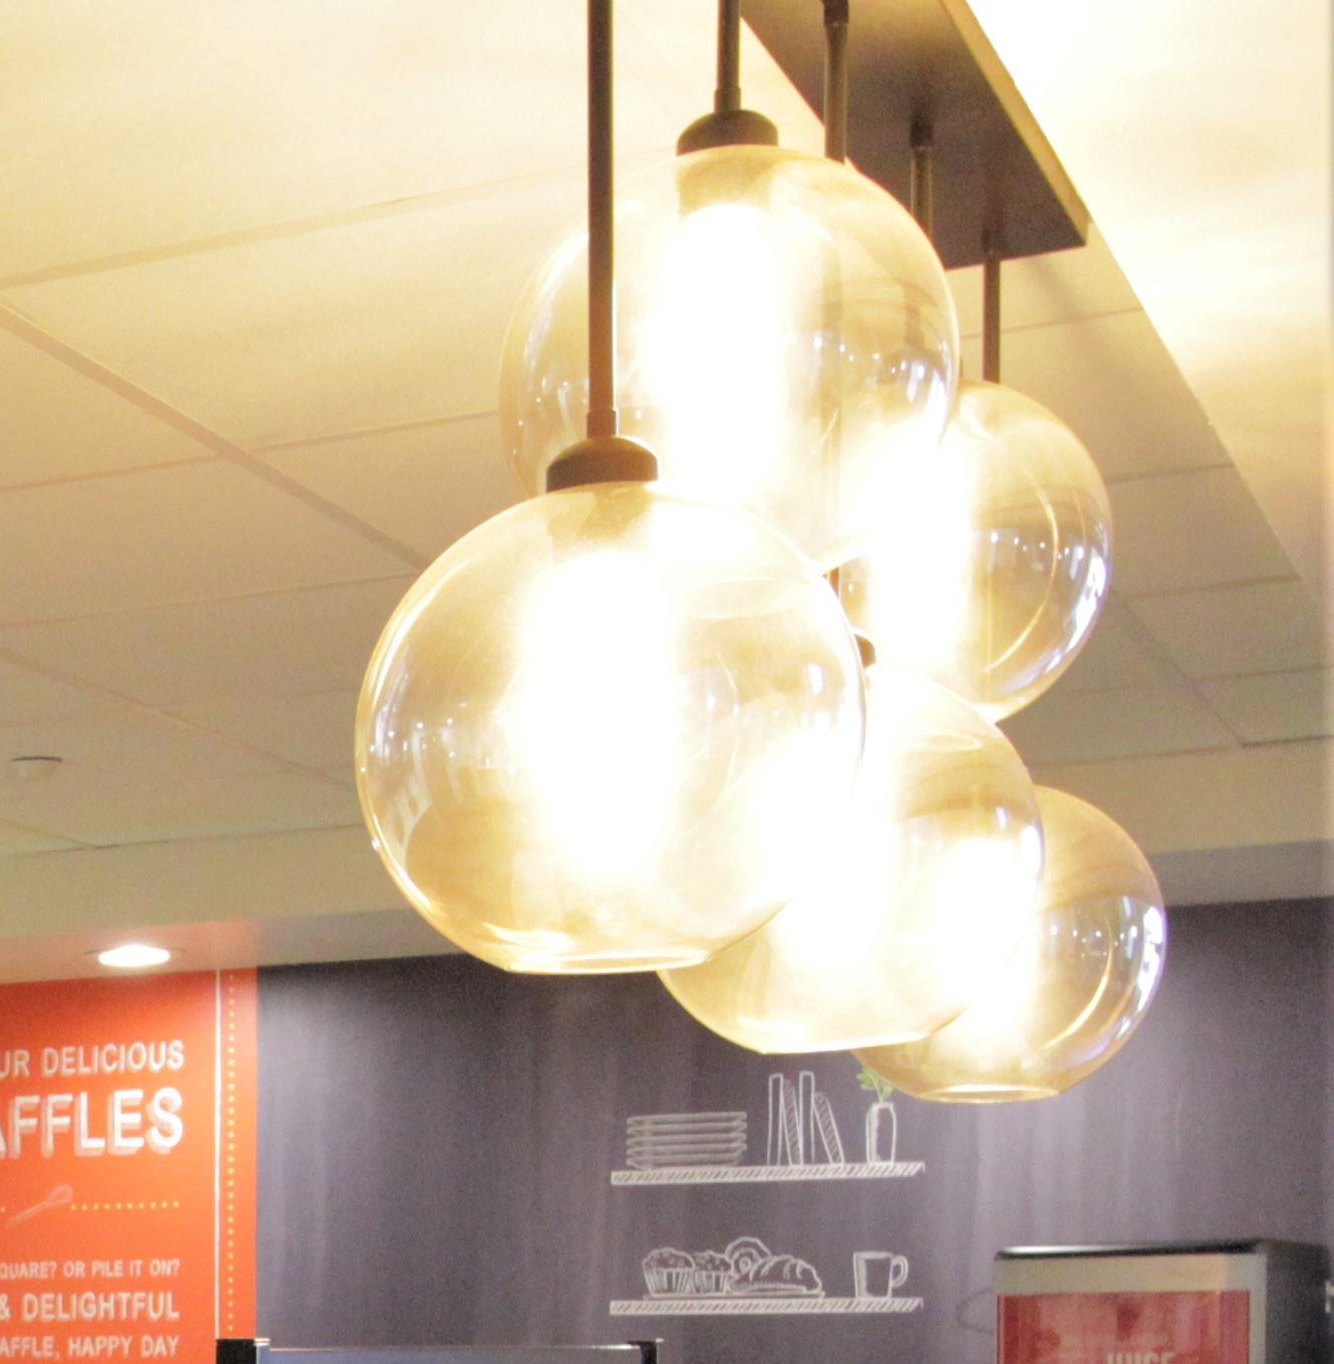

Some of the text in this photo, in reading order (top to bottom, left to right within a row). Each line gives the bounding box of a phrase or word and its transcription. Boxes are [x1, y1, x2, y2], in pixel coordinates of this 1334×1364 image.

[42, 1040, 185, 1077] DELICIOUS
[63, 1260, 85, 1278] OR
[91, 1260, 123, 1278] PILE
[129, 1259, 144, 1277] IT
[149, 1258, 180, 1277] ON?
[22, 1291, 181, 1322] DELIGHTFUL
[68, 1336, 133, 1358] HAPPY
[141, 1335, 180, 1358] DAY
